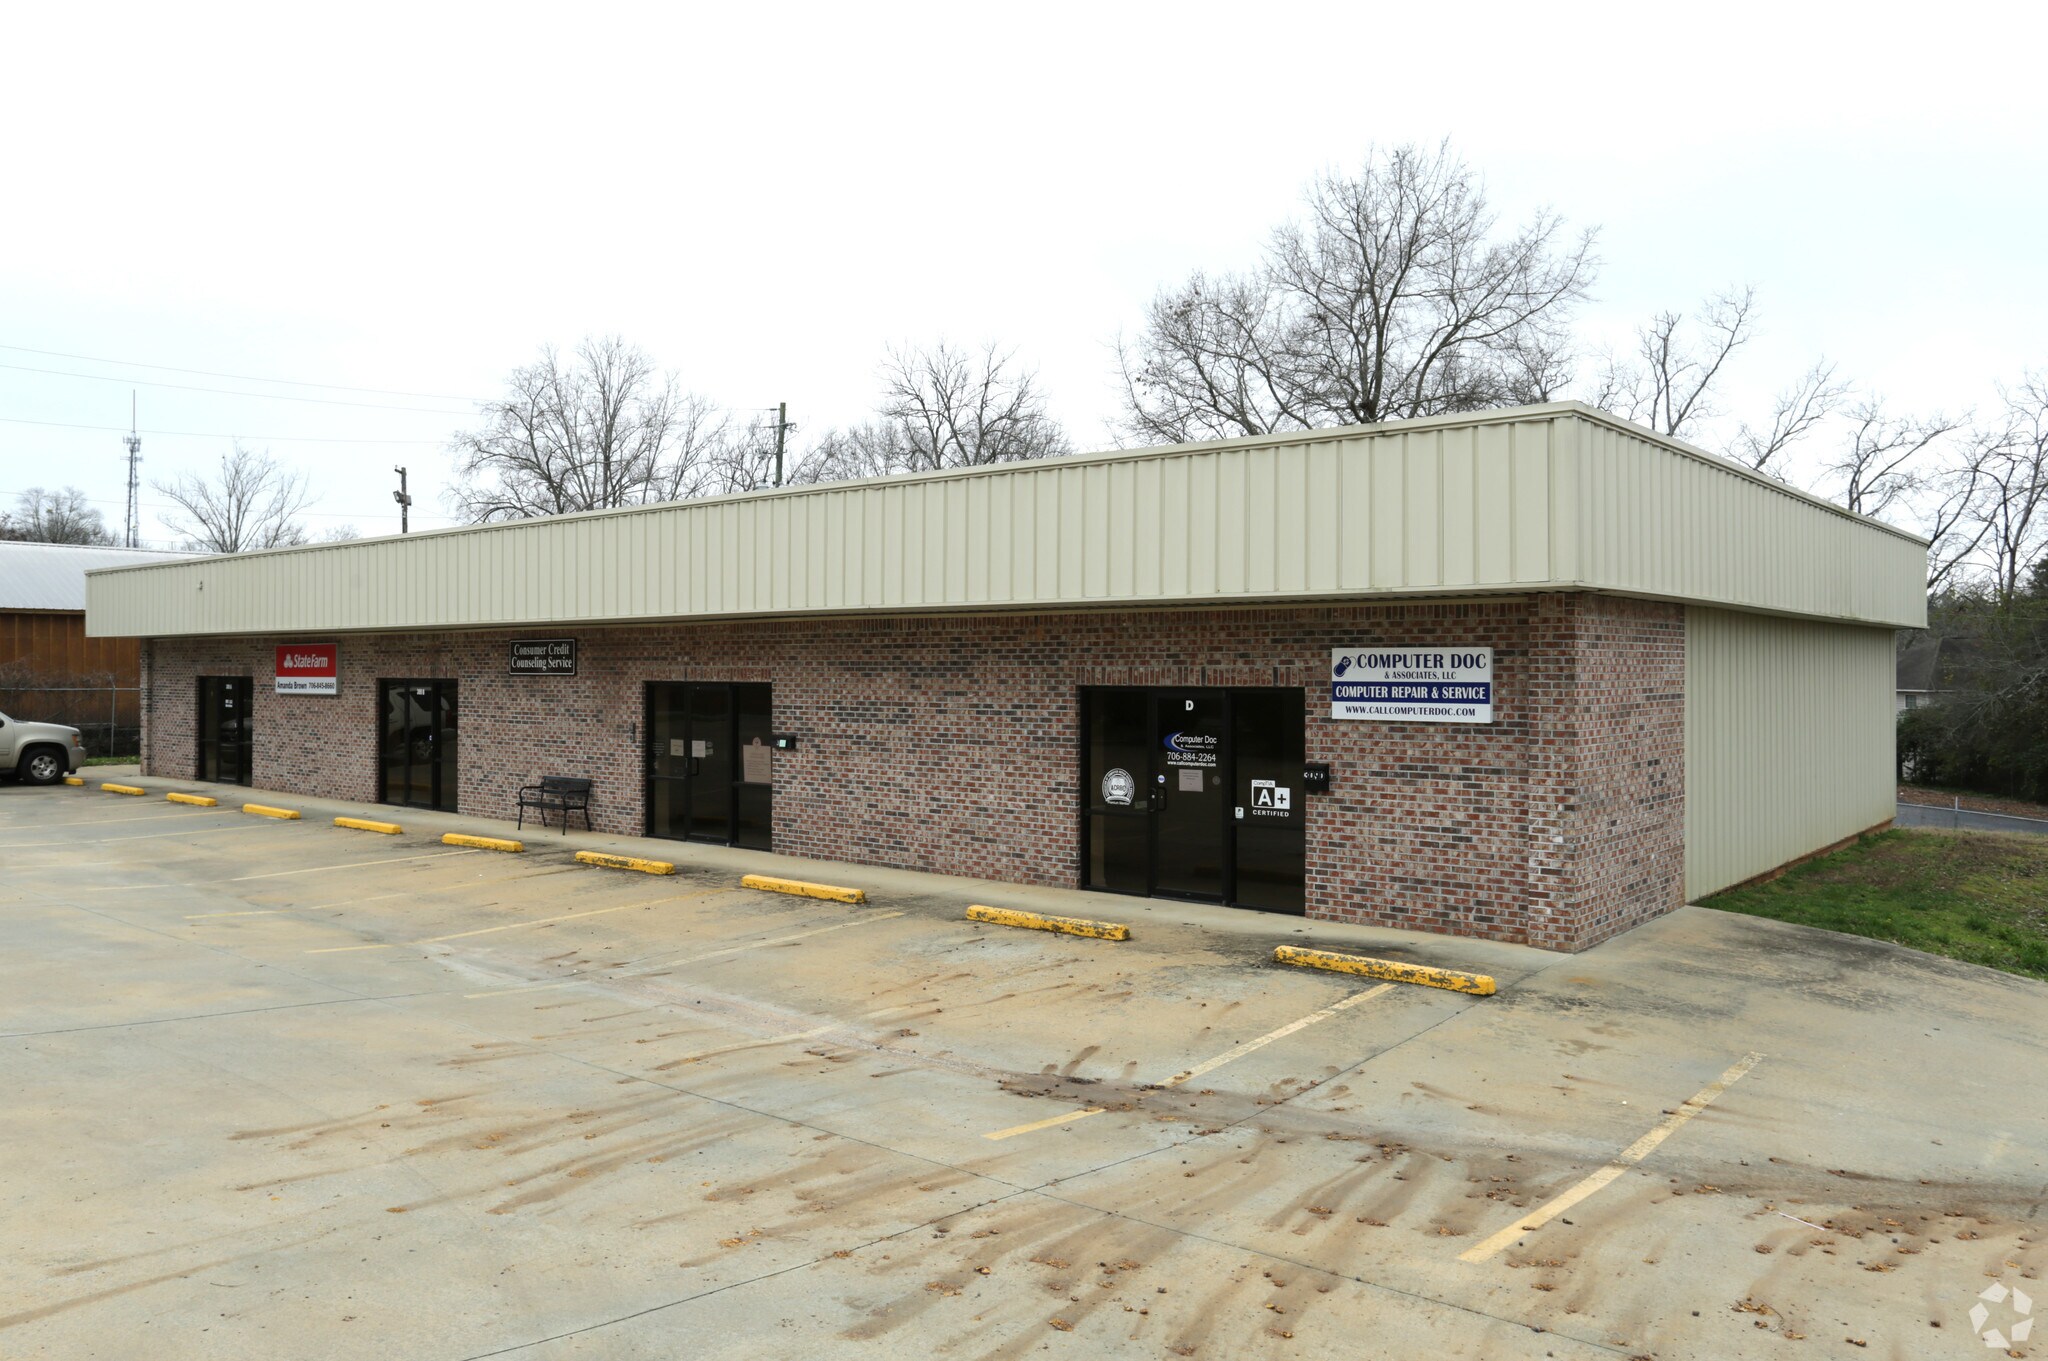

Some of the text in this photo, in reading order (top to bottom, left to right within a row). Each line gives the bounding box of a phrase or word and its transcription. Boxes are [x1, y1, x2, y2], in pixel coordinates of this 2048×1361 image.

[514, 643, 570, 656] Consumer Credit
[511, 656, 573, 671] Counseling Service
[1357, 653, 1487, 669] COMPUTER DOC
[1384, 671, 1457, 681] & ASSOCIATES, LLC
[1335, 685, 1486, 700] COMPUTER REPAIR & SERVICE
[1185, 700, 1194, 711] D
[1345, 705, 1476, 717] WWW.CALLCOMPUTERDOC.COM
[1175, 734, 1217, 745] Computer Doc
[1167, 751, 1217, 762] 706-884-2264
[1252, 809, 1290, 818] CERTIFIED
